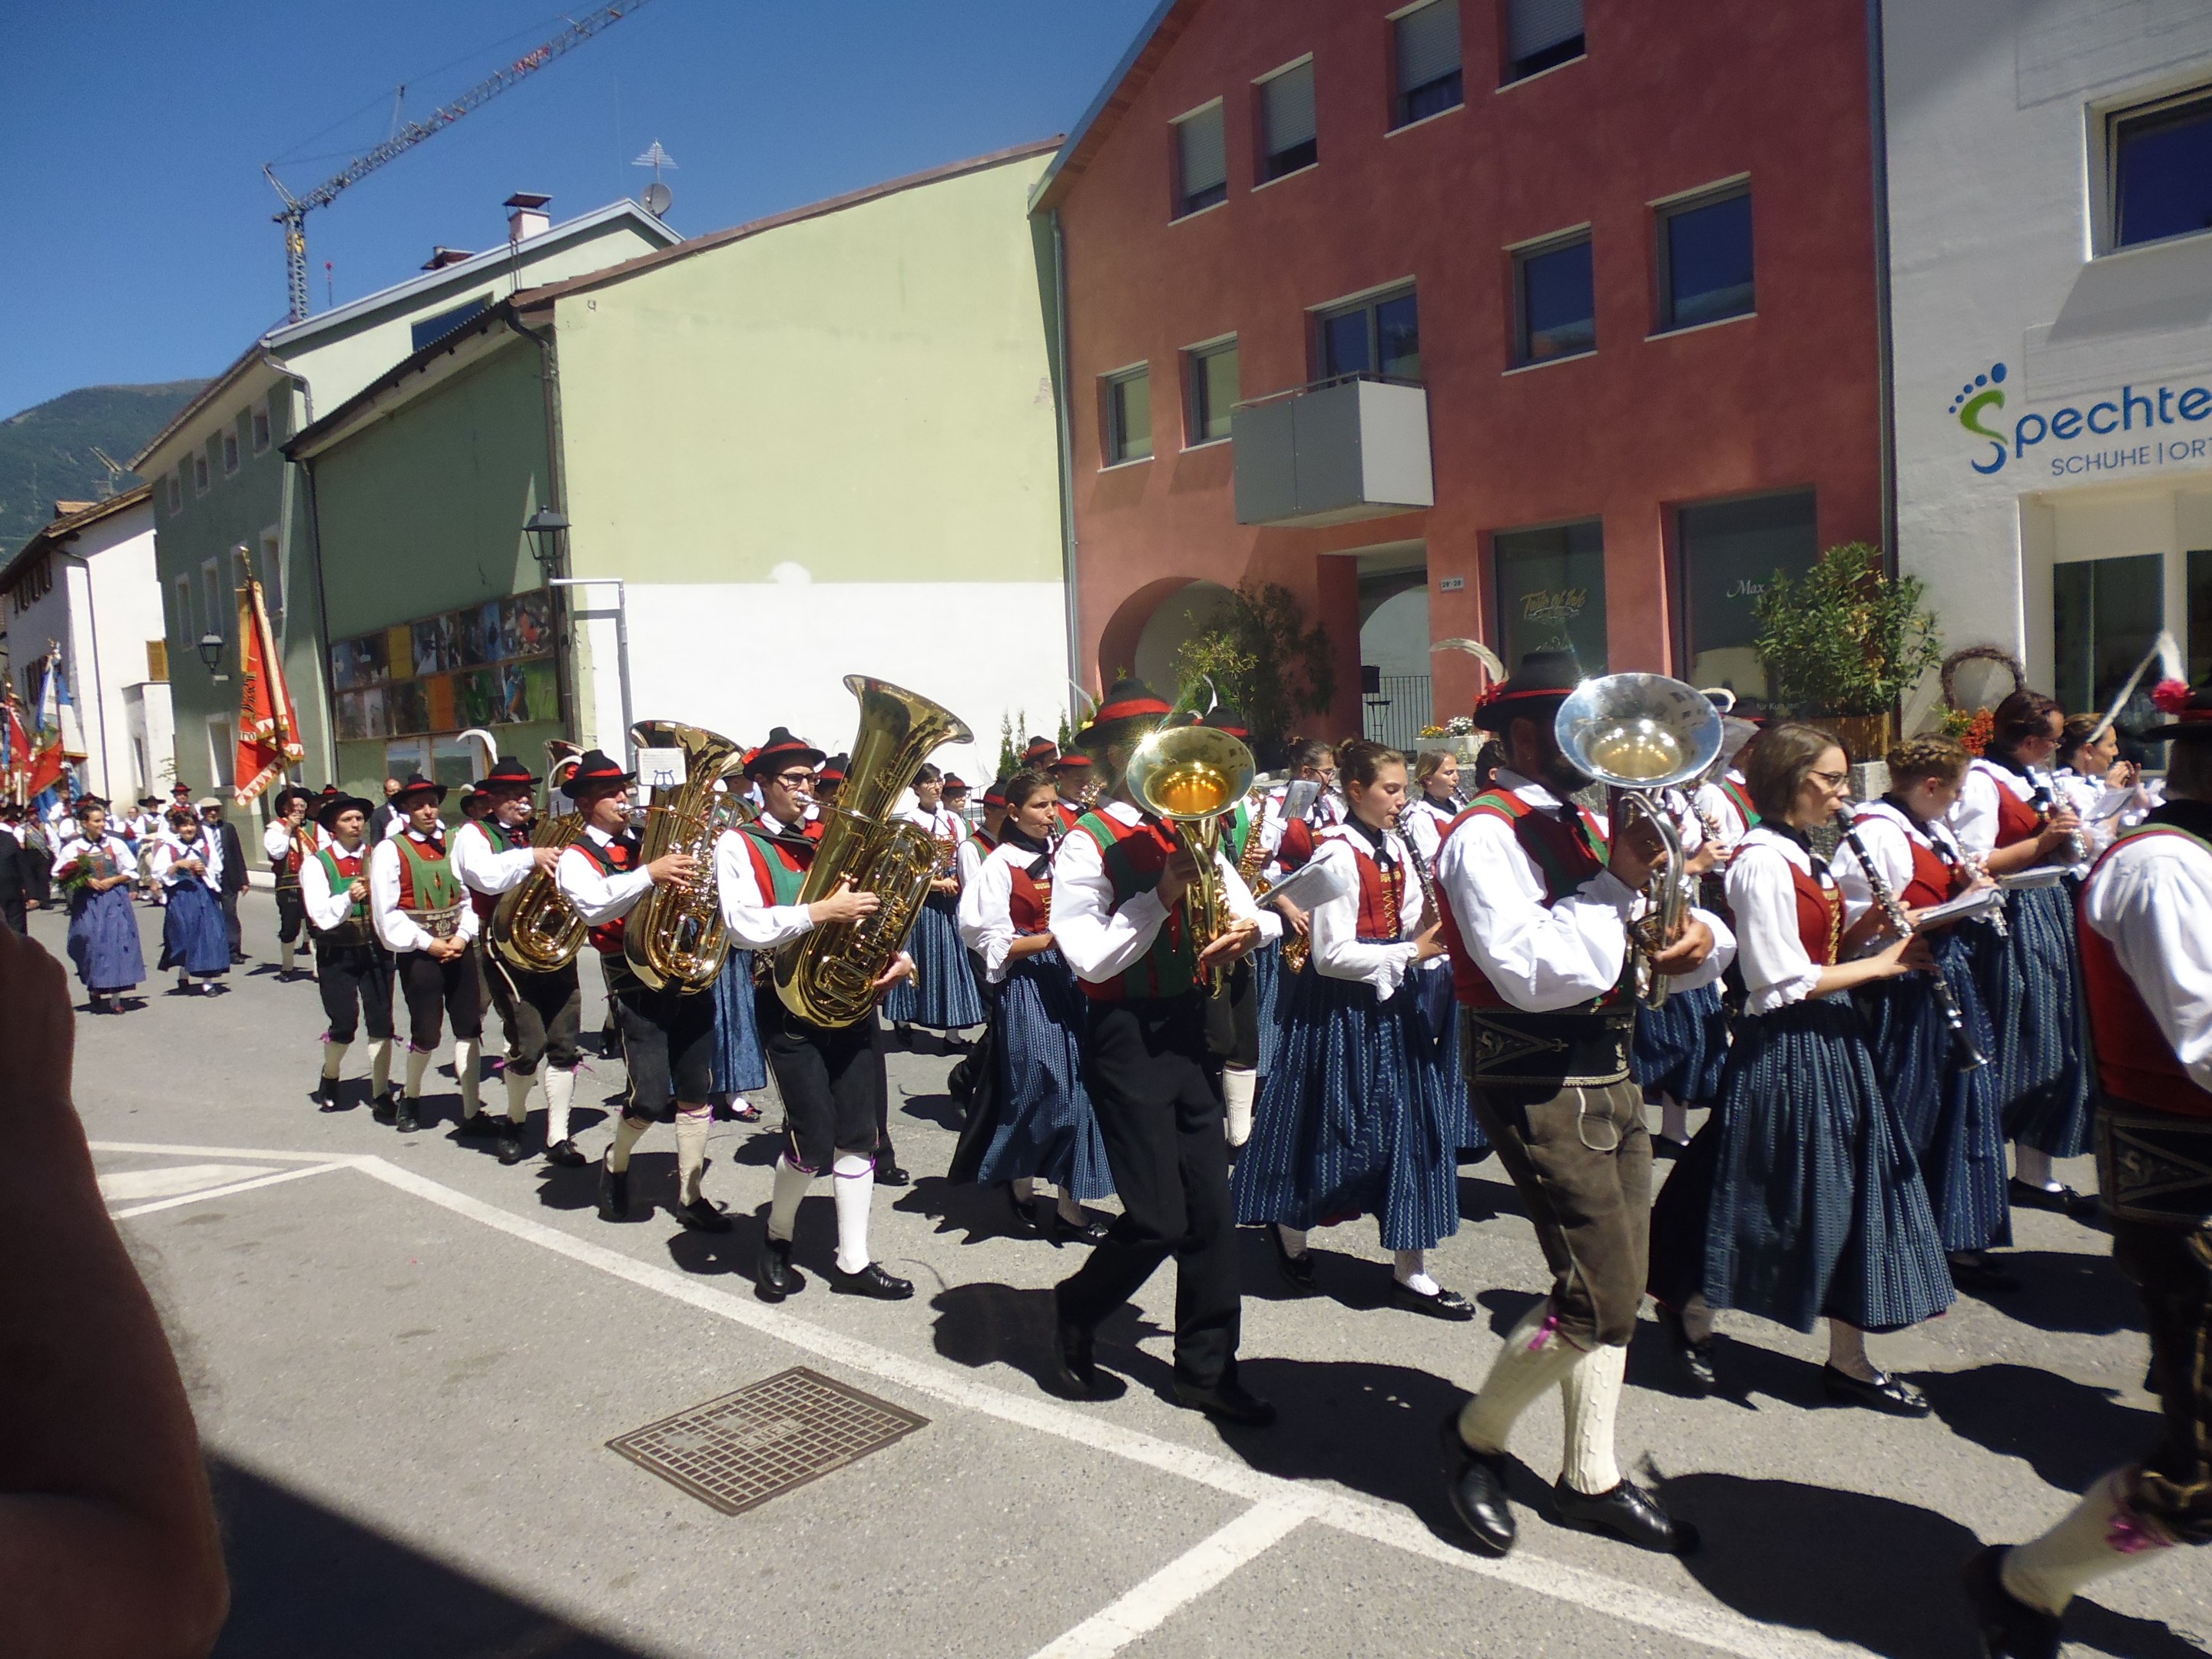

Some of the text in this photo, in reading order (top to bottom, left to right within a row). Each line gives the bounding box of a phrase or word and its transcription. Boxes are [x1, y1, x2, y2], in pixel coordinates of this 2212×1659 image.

[1960, 386, 2212, 474] Spechte
[2051, 438, 2212, 476] SCHUHE OR
